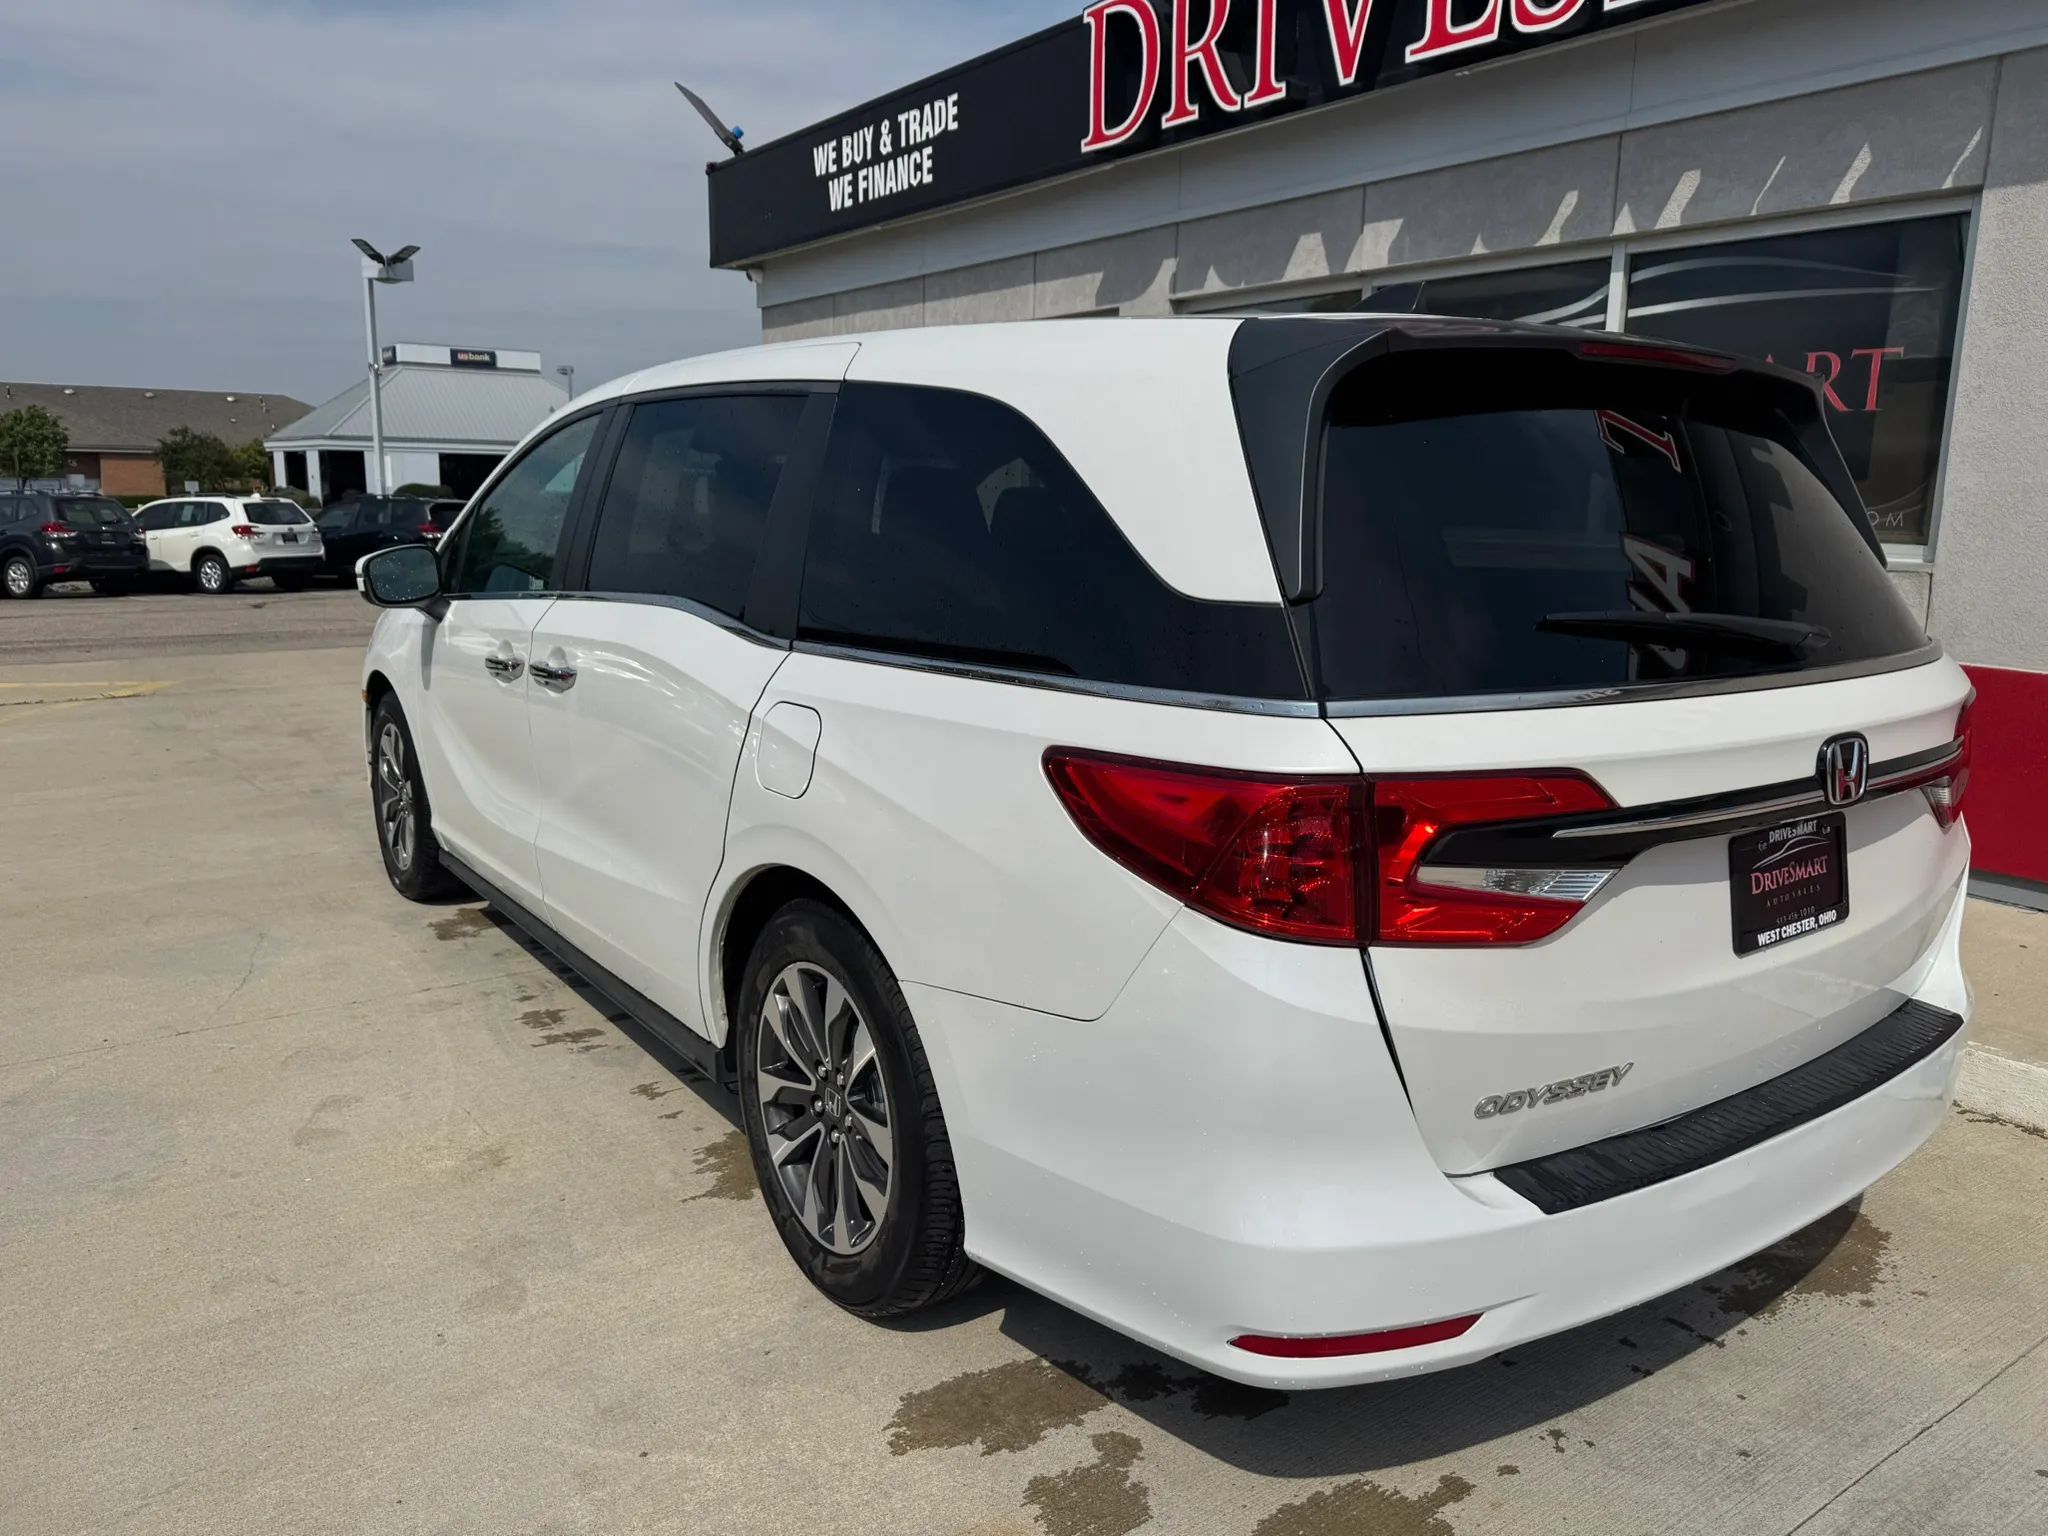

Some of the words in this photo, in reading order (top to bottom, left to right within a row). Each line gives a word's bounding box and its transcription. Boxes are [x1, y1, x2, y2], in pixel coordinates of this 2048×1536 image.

[1081, 0, 1648, 153] DRIV
[813, 139, 837, 177] WE
[841, 124, 874, 168] BUY
[879, 118, 893, 155] &
[897, 92, 959, 148] TRADE
[828, 173, 853, 212] WE
[858, 145, 933, 204] FINANCE
[1765, 347, 1905, 412] RT
[1751, 855, 1829, 895] DRIVESMART
[1757, 927, 1781, 947] WEST
[1781, 916, 1818, 939] CHESTER,
[1818, 909, 1837, 926] OHIO
[1474, 1062, 1634, 1119] ODYSSEY
